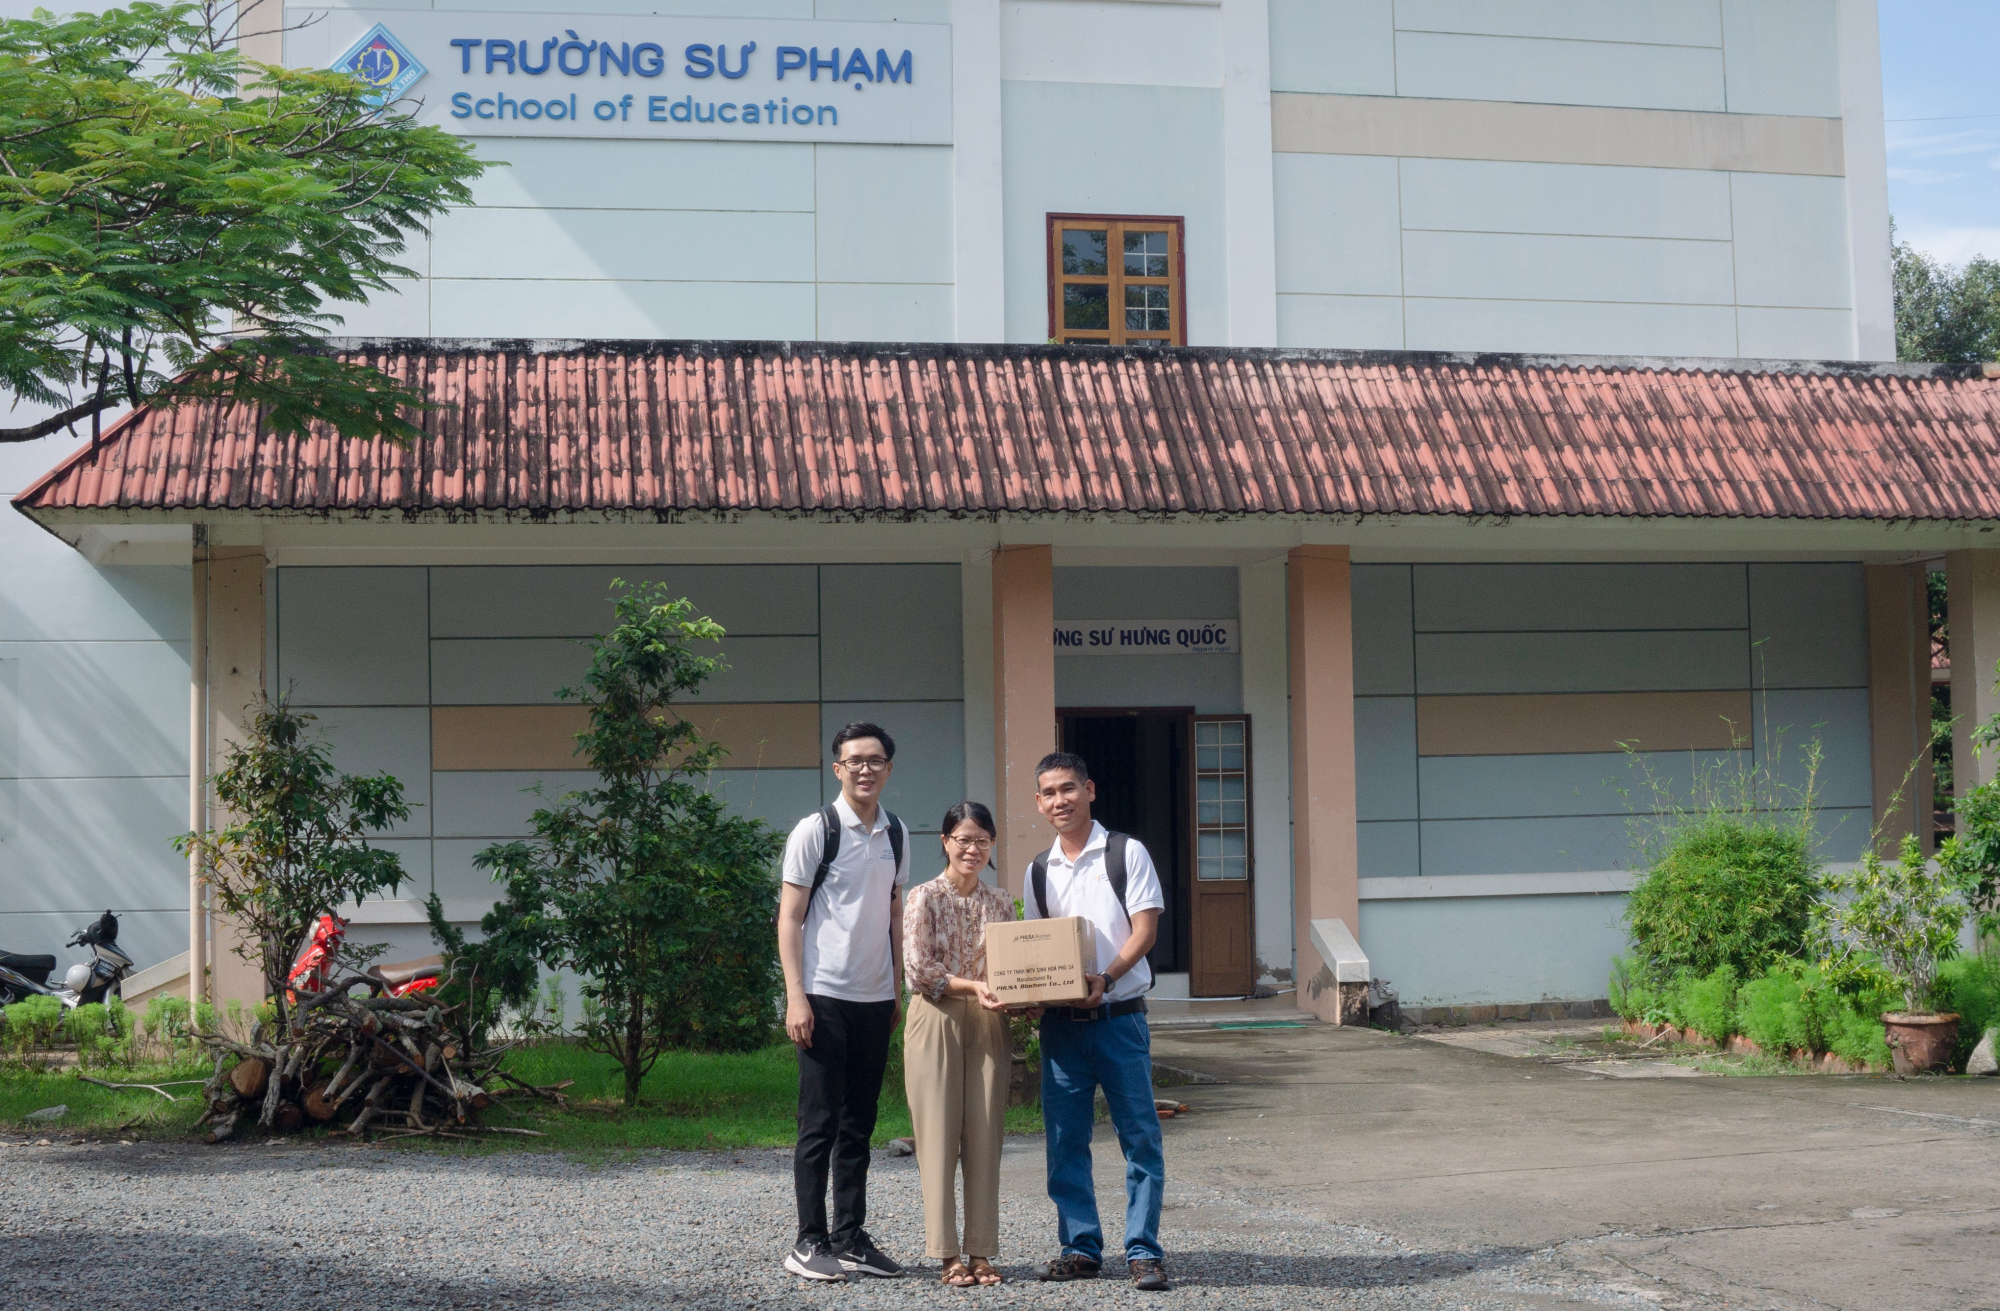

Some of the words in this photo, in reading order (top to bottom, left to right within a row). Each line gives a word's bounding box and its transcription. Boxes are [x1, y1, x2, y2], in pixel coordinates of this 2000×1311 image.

[450, 29, 665, 77] TRƯỜNG
[684, 40, 757, 79] SƯ
[776, 46, 913, 90] PHẠM
[450, 91, 576, 120] School
[593, 94, 634, 121] of
[648, 94, 838, 125] Education
[1089, 627, 1115, 646] SƯ
[1120, 627, 1171, 646] HƯNG
[1176, 624, 1227, 648] QUỐC
